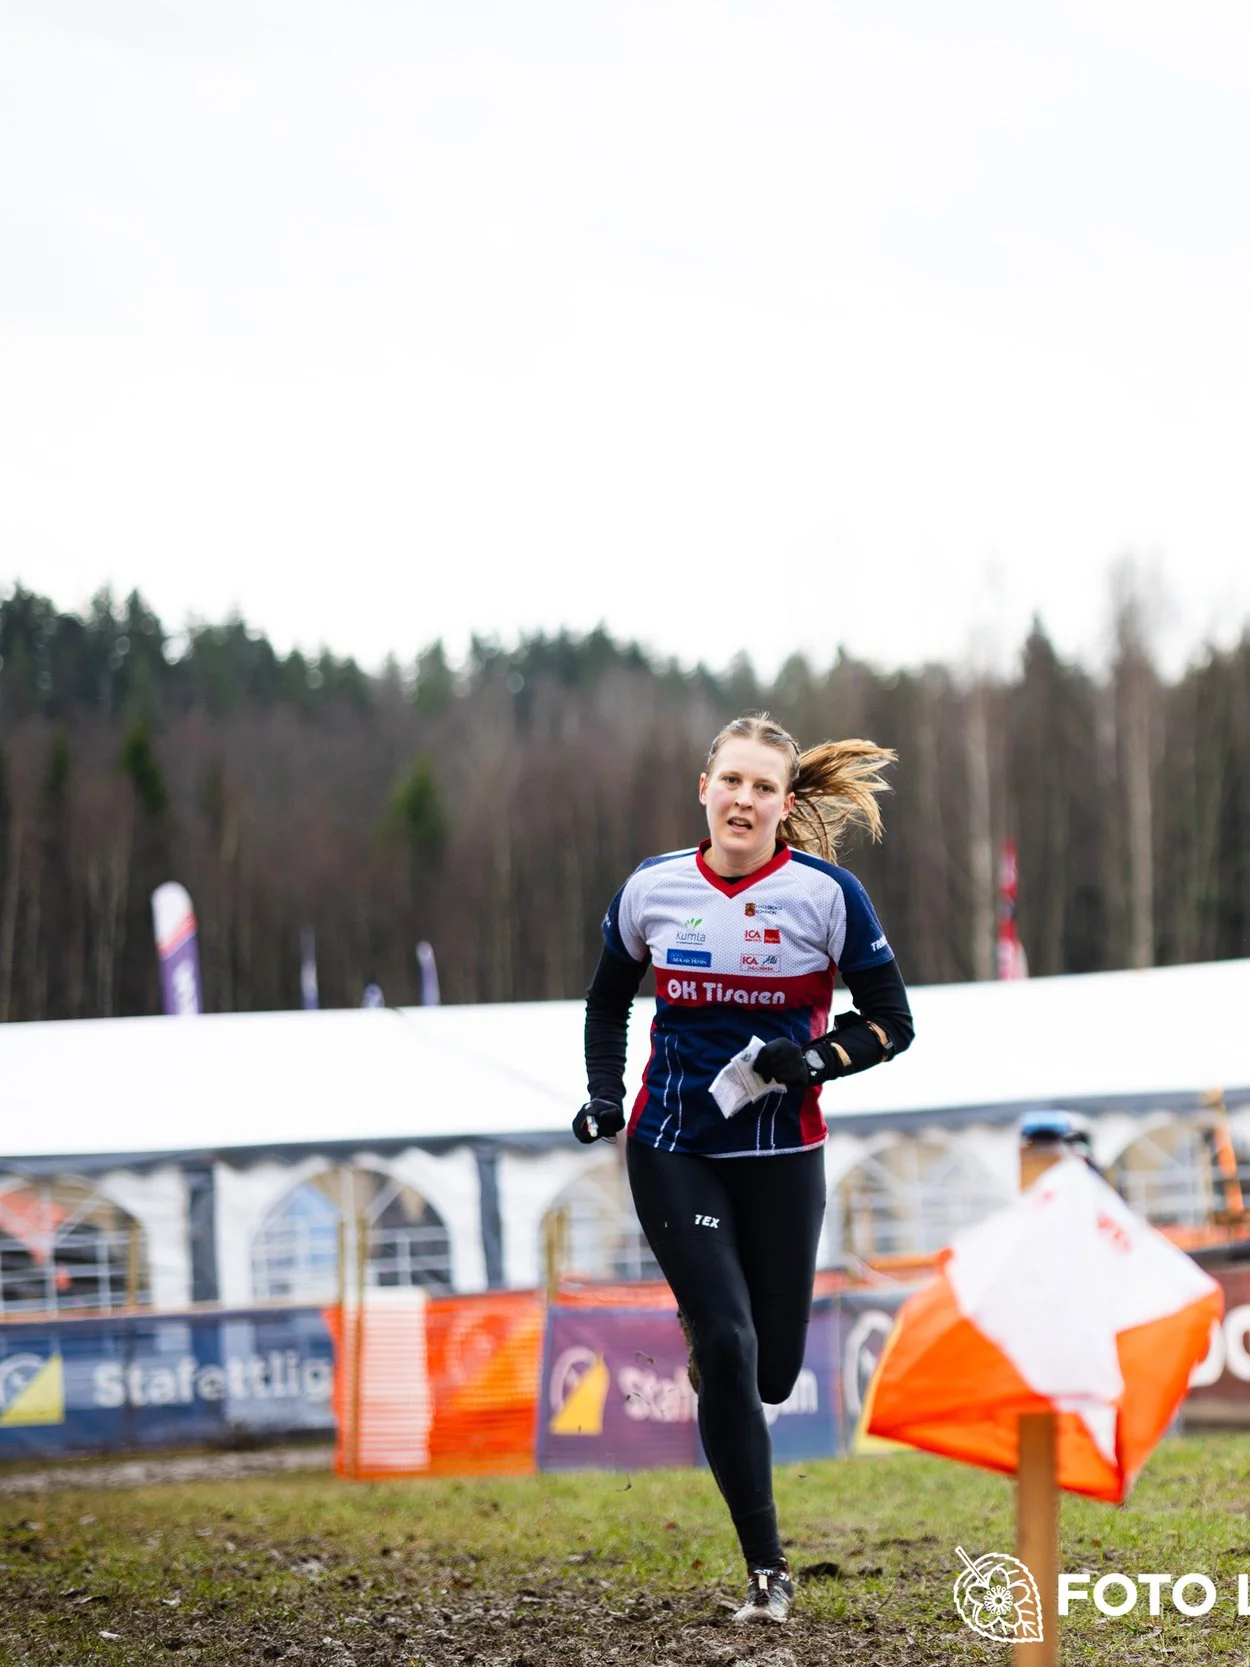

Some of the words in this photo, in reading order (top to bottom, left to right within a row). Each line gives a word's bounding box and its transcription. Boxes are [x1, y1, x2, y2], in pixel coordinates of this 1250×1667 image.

[667, 978, 697, 1000] OK
[702, 982, 786, 1005] Tisaren
[695, 1214, 720, 1229] TEX
